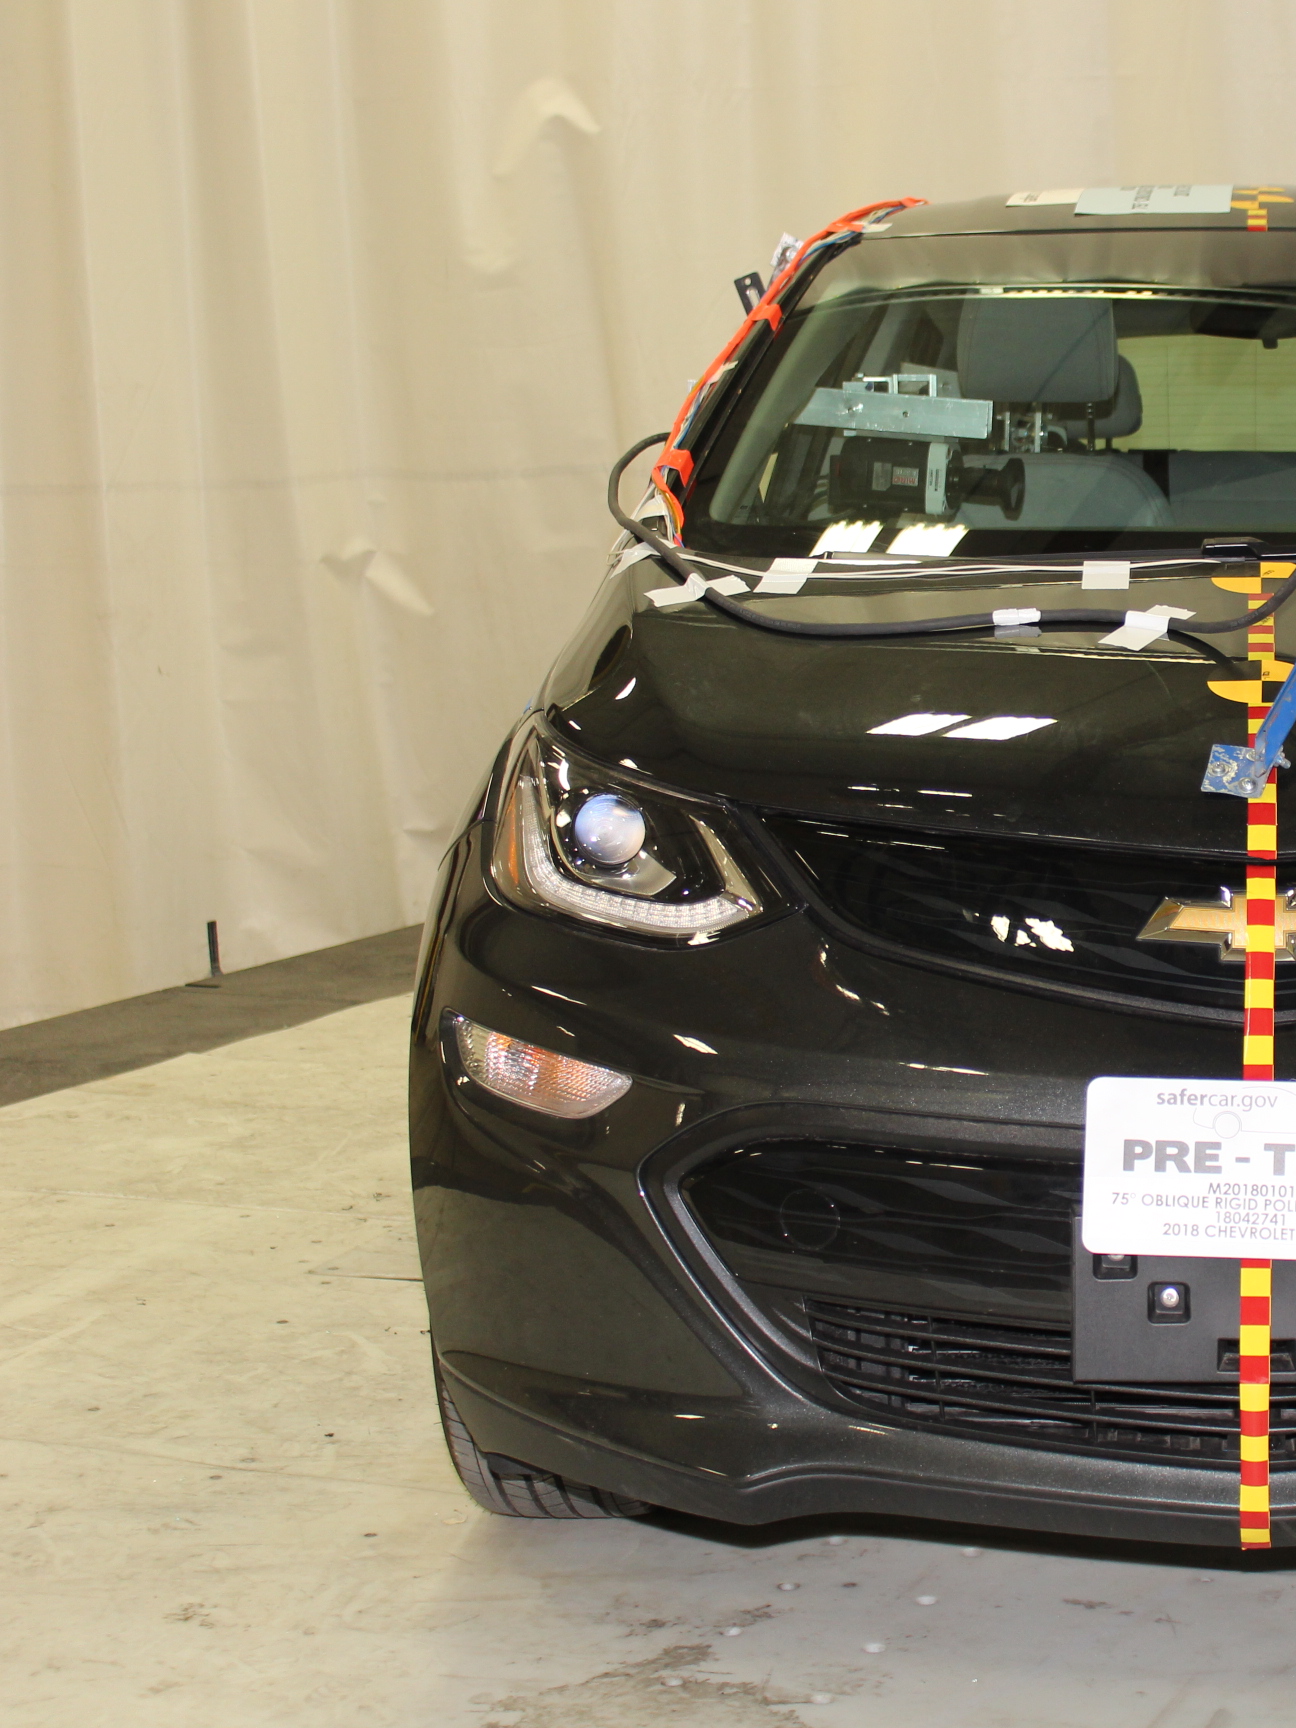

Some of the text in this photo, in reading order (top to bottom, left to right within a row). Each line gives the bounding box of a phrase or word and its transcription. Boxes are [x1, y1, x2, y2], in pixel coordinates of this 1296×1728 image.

[1156, 1089, 1278, 1112] safercar.gov
[1123, 1139, 1222, 1174] PRE
[1208, 1183, 1295, 1198] M20180101
[1111, 1192, 1136, 1205] 75°
[1142, 1194, 1209, 1209] OBLIQUE
[1215, 1197, 1258, 1211] RIGID
[1215, 1211, 1286, 1225] 18042741
[1163, 1223, 1200, 1237] 2018
[1205, 1225, 1295, 1241] CHEVROLET
